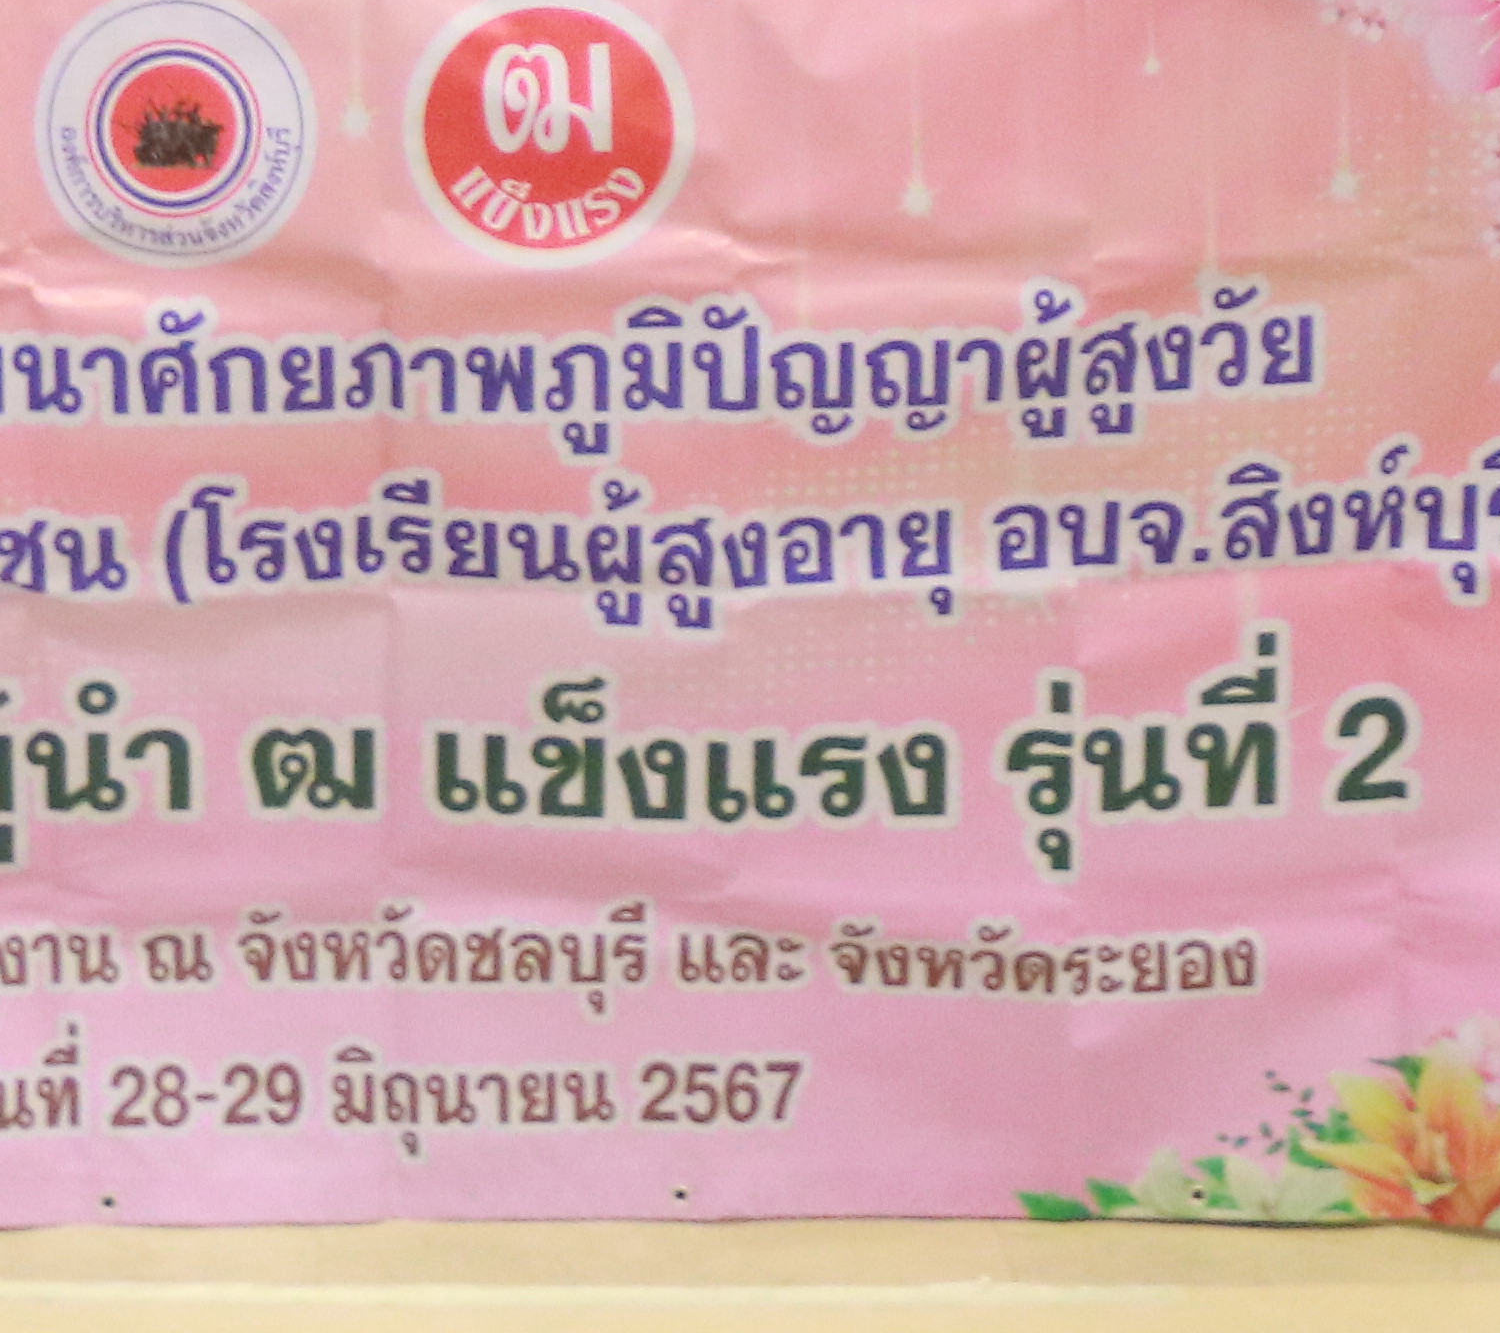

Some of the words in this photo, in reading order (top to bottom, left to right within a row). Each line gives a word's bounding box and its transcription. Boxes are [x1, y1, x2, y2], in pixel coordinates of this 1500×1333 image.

[447, 164, 648, 242] แข็งแรง
[165, 477, 954, 630] (โรงเรียนผู้สูงอายุ
[250, 727, 376, 811] ฒ
[434, 675, 948, 821] แข็งแรง
[1005, 631, 1279, 873] รุ่นที่
[1335, 696, 1409, 804] 2
[144, 933, 212, 983] ณ
[239, 902, 646, 1013] จังหวัดชลบุรี
[678, 932, 804, 985] และ
[830, 918, 1256, 997] จังหวัดระยอง
[111, 1063, 302, 1128] 28-29
[334, 1047, 613, 1157] มิถุนายน
[640, 1060, 801, 1125] 2567
